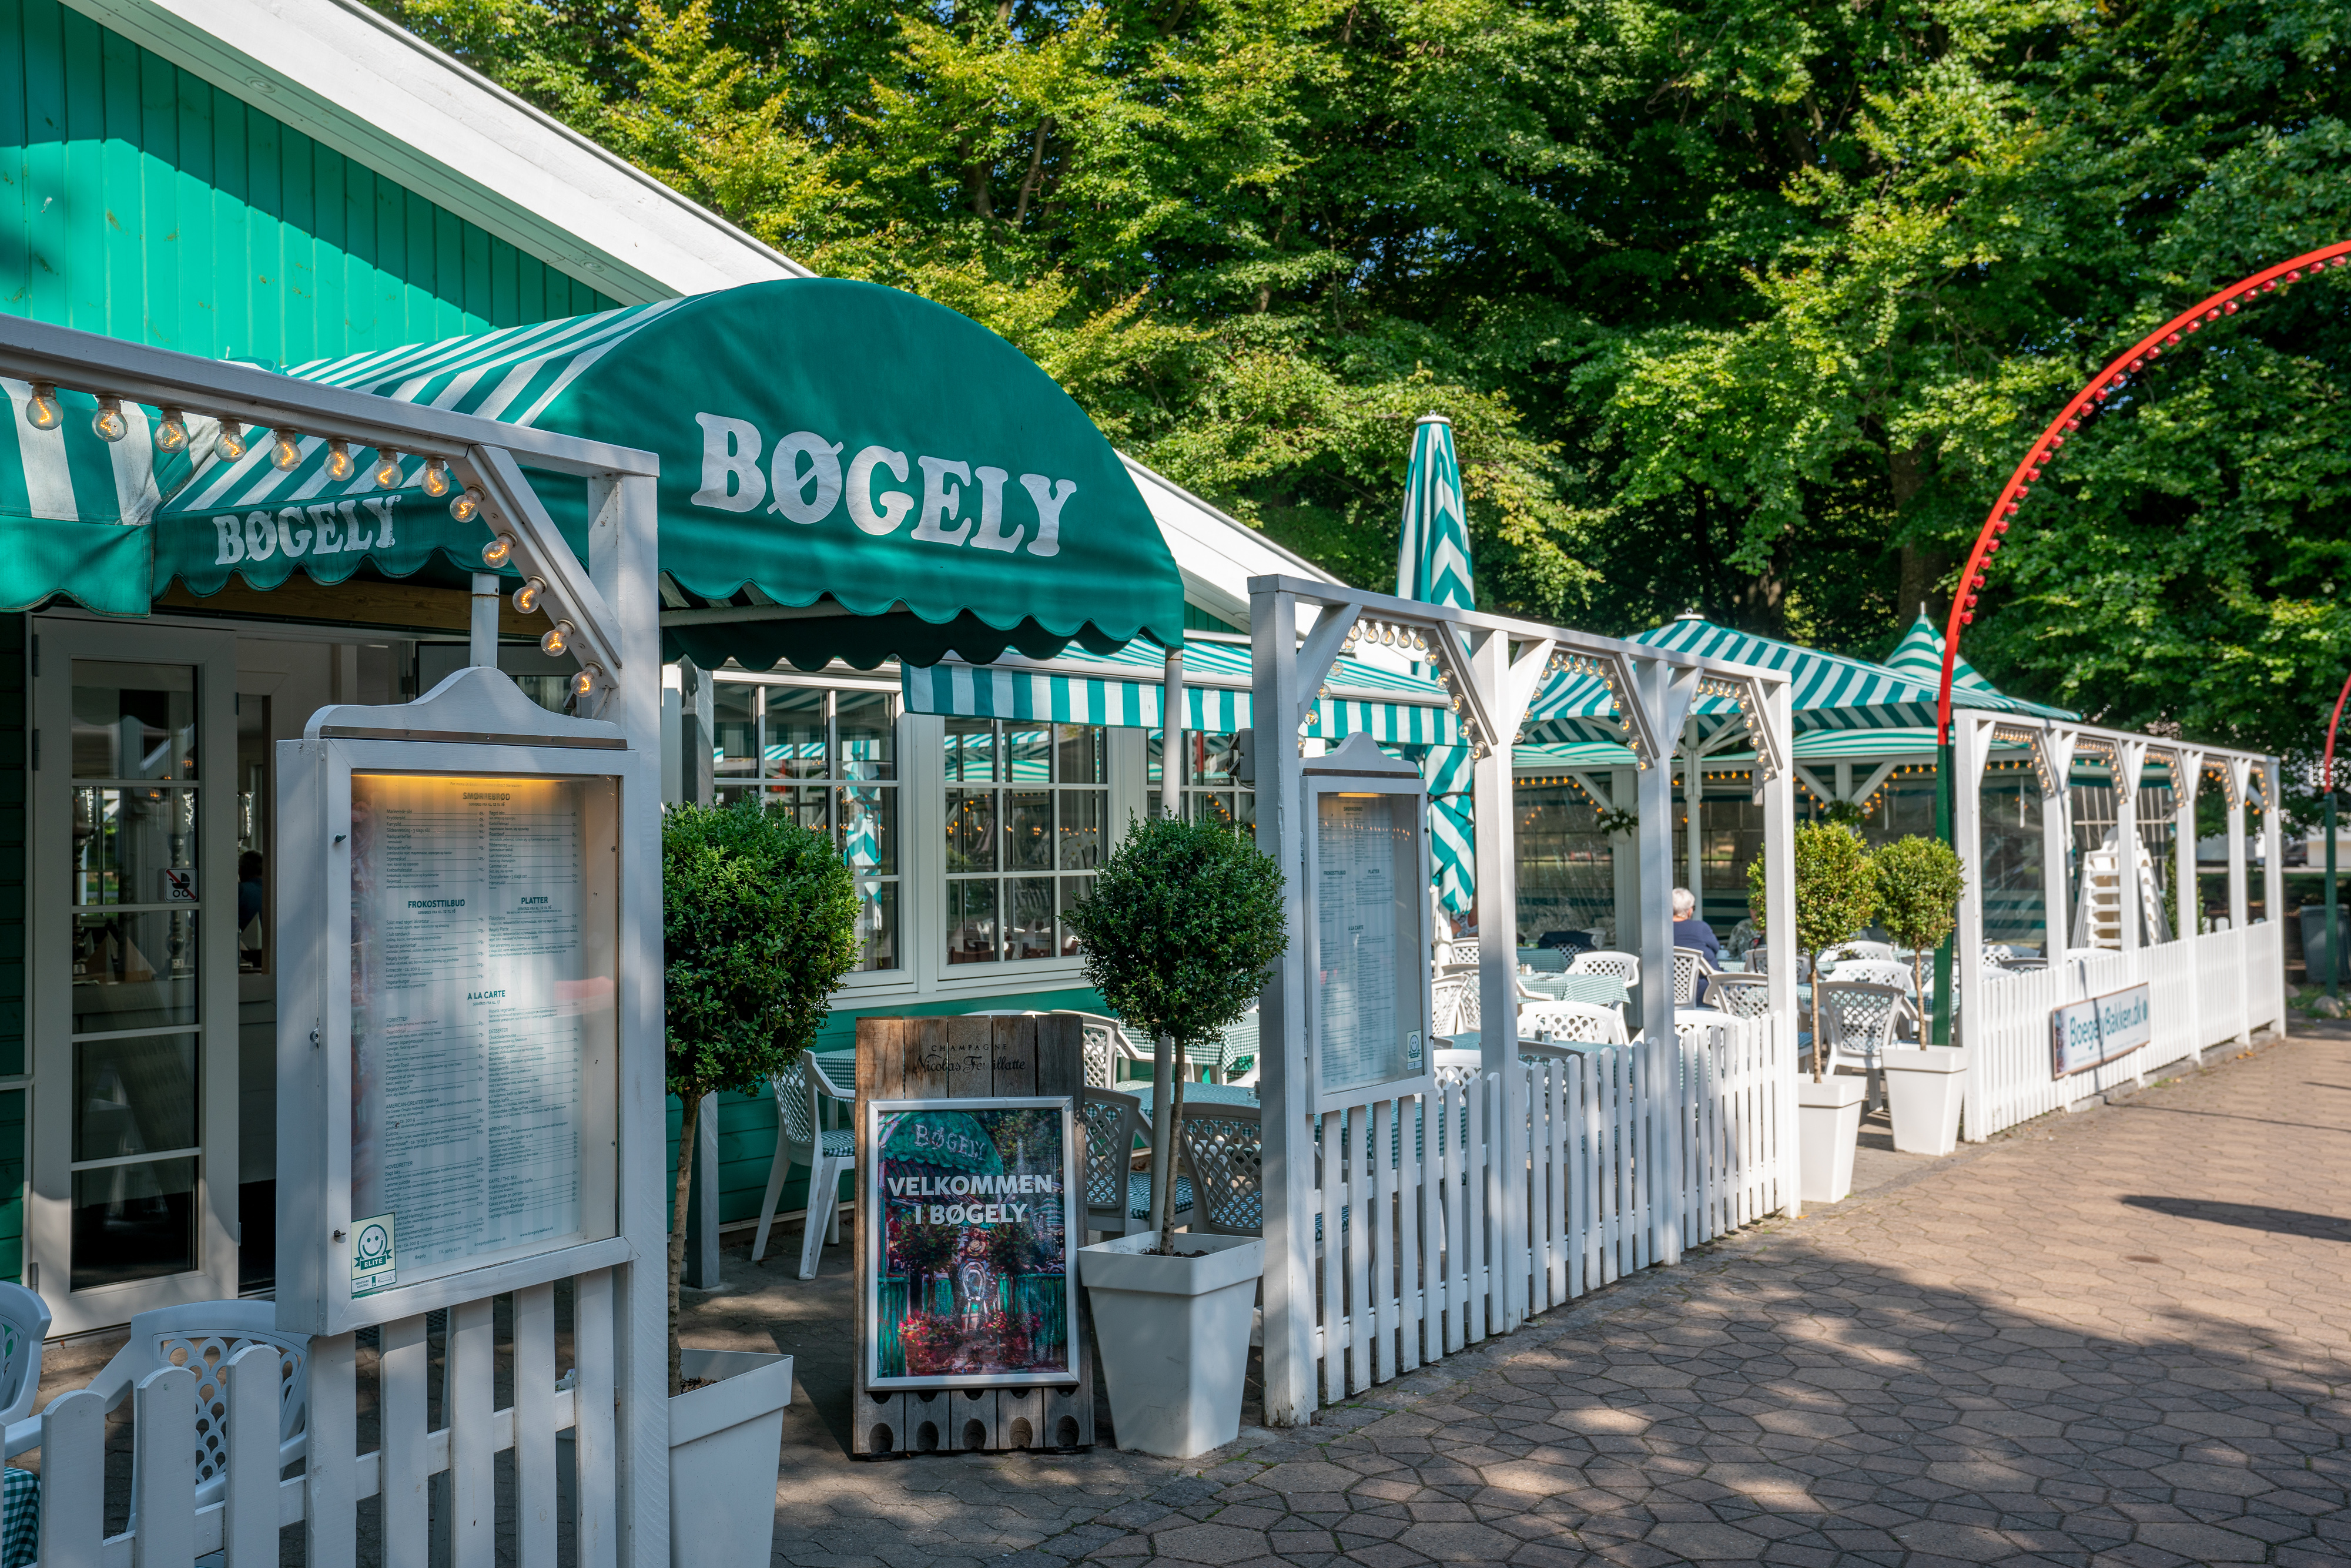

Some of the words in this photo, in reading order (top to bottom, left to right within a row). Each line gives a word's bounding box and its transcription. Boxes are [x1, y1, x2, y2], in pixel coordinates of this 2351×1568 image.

[691, 411, 1077, 557] BØGELY
[212, 494, 401, 565] BØGELY
[408, 899, 465, 909] FROKOSTTILBUD
[521, 896, 548, 904] PLATTER
[474, 991, 483, 1000] LA
[484, 990, 505, 999] CARTE
[931, 1043, 1007, 1051] CHAMPAGNE
[912, 1054, 960, 1074] Nicolas
[963, 1055, 1026, 1073] Feillatte
[386, 1099, 424, 1109] AMERICAN-GREATER
[488, 1124, 512, 1133] BØRNEMENU
[385, 1161, 413, 1170] HOVEDRETTER
[887, 1174, 1053, 1197] VELKOMMEN
[915, 1205, 922, 1225] I
[930, 1202, 1028, 1227] BØGELY
[364, 1258, 383, 1267] ELITE
